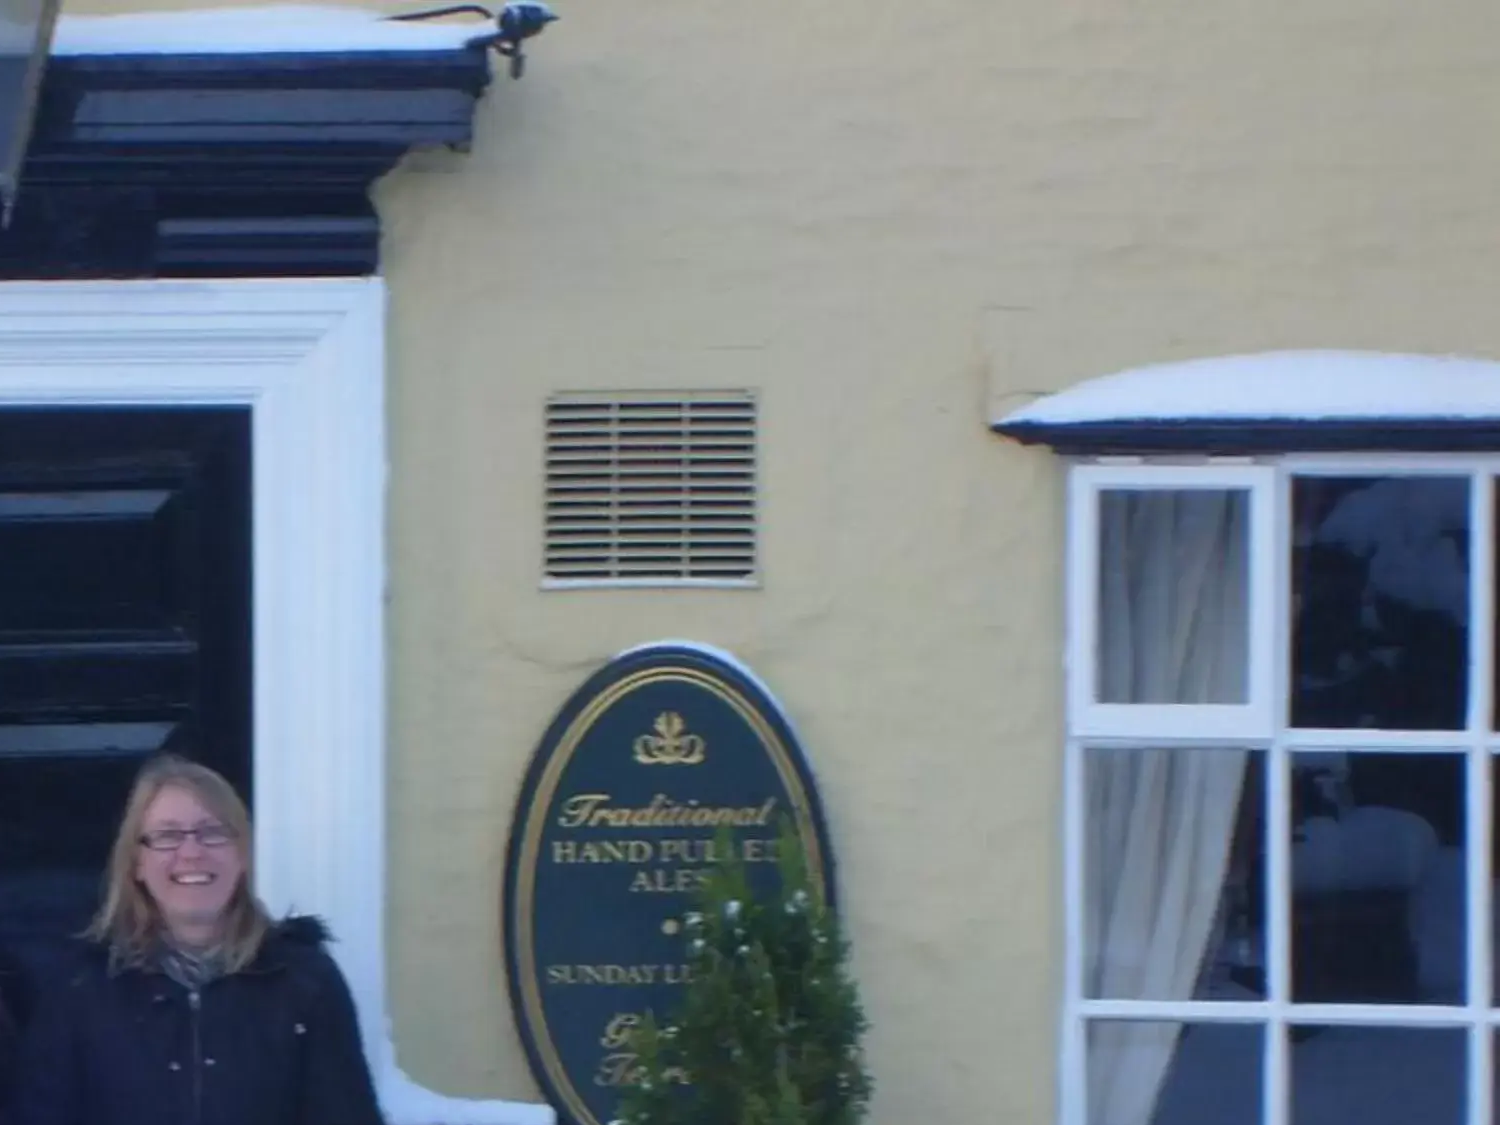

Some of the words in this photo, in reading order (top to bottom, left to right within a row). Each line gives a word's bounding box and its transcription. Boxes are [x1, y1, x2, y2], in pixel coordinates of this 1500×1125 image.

[558, 794, 774, 828] Traditional
[551, 840, 653, 863] HAND
[546, 963, 656, 984] SUNDAY
